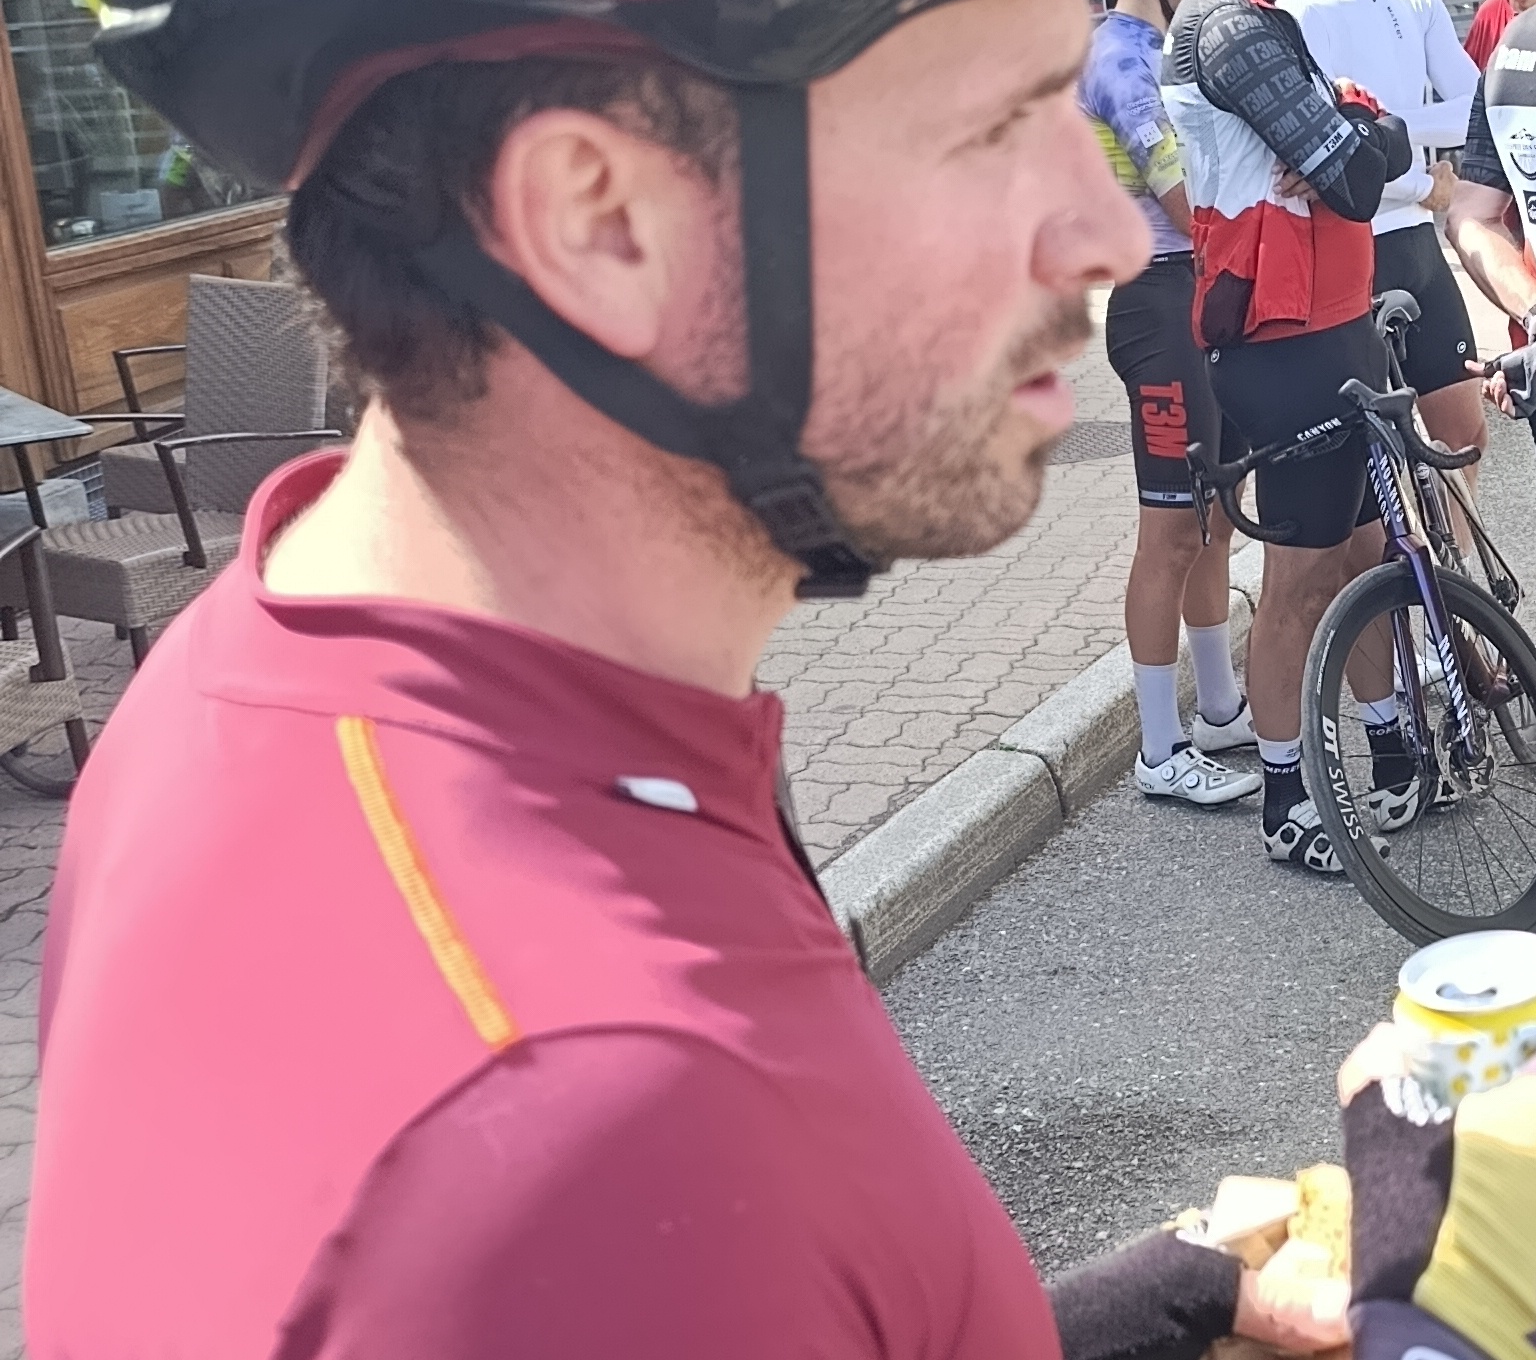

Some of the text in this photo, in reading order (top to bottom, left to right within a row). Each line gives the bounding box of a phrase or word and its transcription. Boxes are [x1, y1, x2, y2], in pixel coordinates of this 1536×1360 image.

[1322, 131, 1343, 153] T3M
[1140, 382, 1188, 459] T3M
[1297, 417, 1343, 441] CANYON
[1379, 453, 1404, 523] CANYON
[1438, 633, 1472, 738] CANYON
[1322, 715, 1340, 761] DT
[1328, 766, 1364, 840] SWISS
